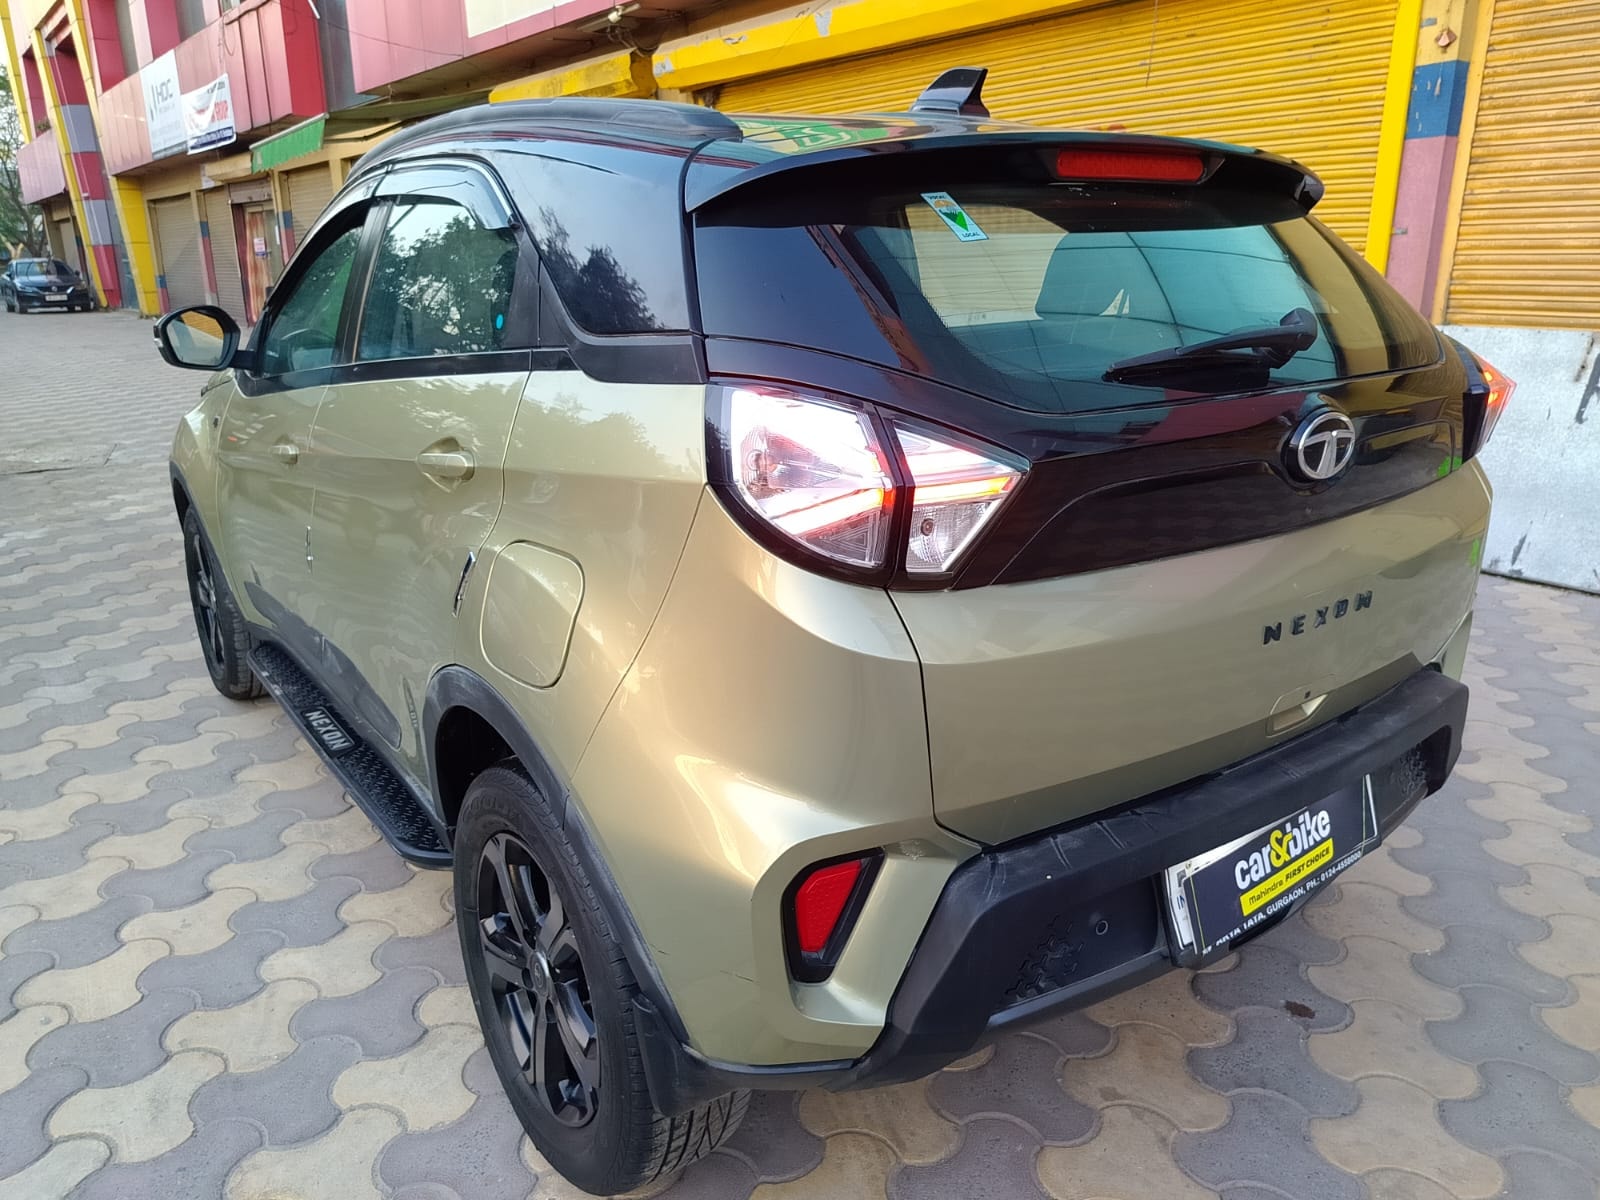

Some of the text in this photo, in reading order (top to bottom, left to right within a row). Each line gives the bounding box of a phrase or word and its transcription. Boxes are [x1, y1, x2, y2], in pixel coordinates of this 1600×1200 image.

[1263, 590, 1372, 645] NEXON
[305, 710, 351, 750] NEXON
[1249, 846, 1330, 905] Mahindra FIRST CHOICE
